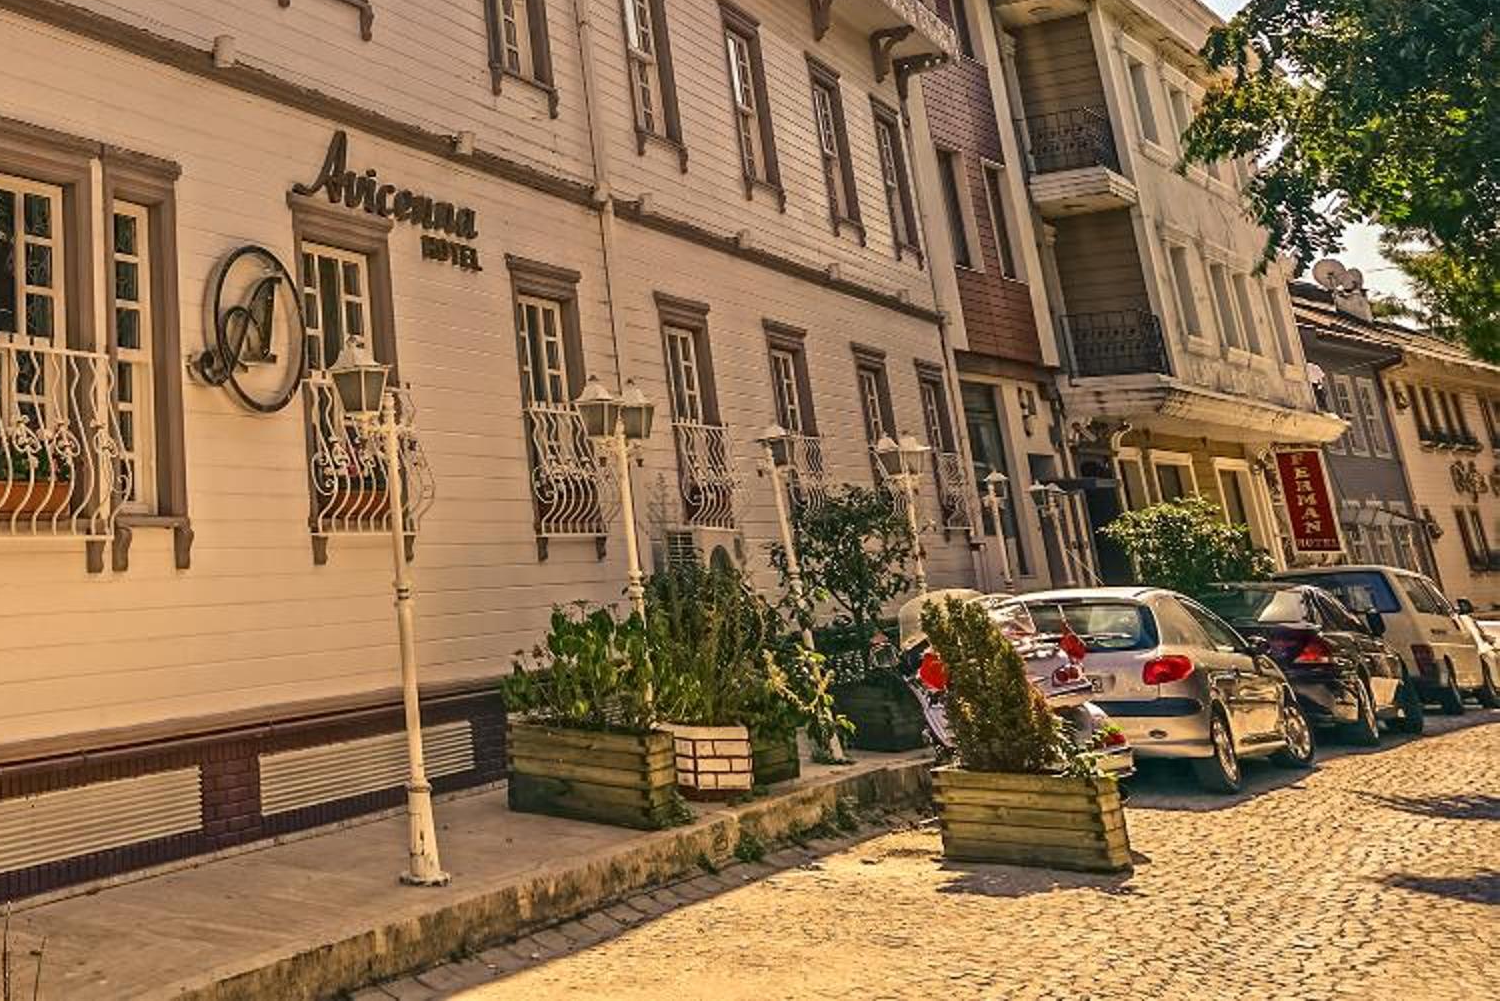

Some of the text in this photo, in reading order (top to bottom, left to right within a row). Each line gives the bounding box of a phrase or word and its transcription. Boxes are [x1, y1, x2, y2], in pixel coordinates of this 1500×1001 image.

[291, 130, 479, 240] Avicenna
[419, 234, 483, 272] HOTEL
[1290, 454, 1322, 534] FERMAN
[1295, 538, 1340, 549] HOTEL
